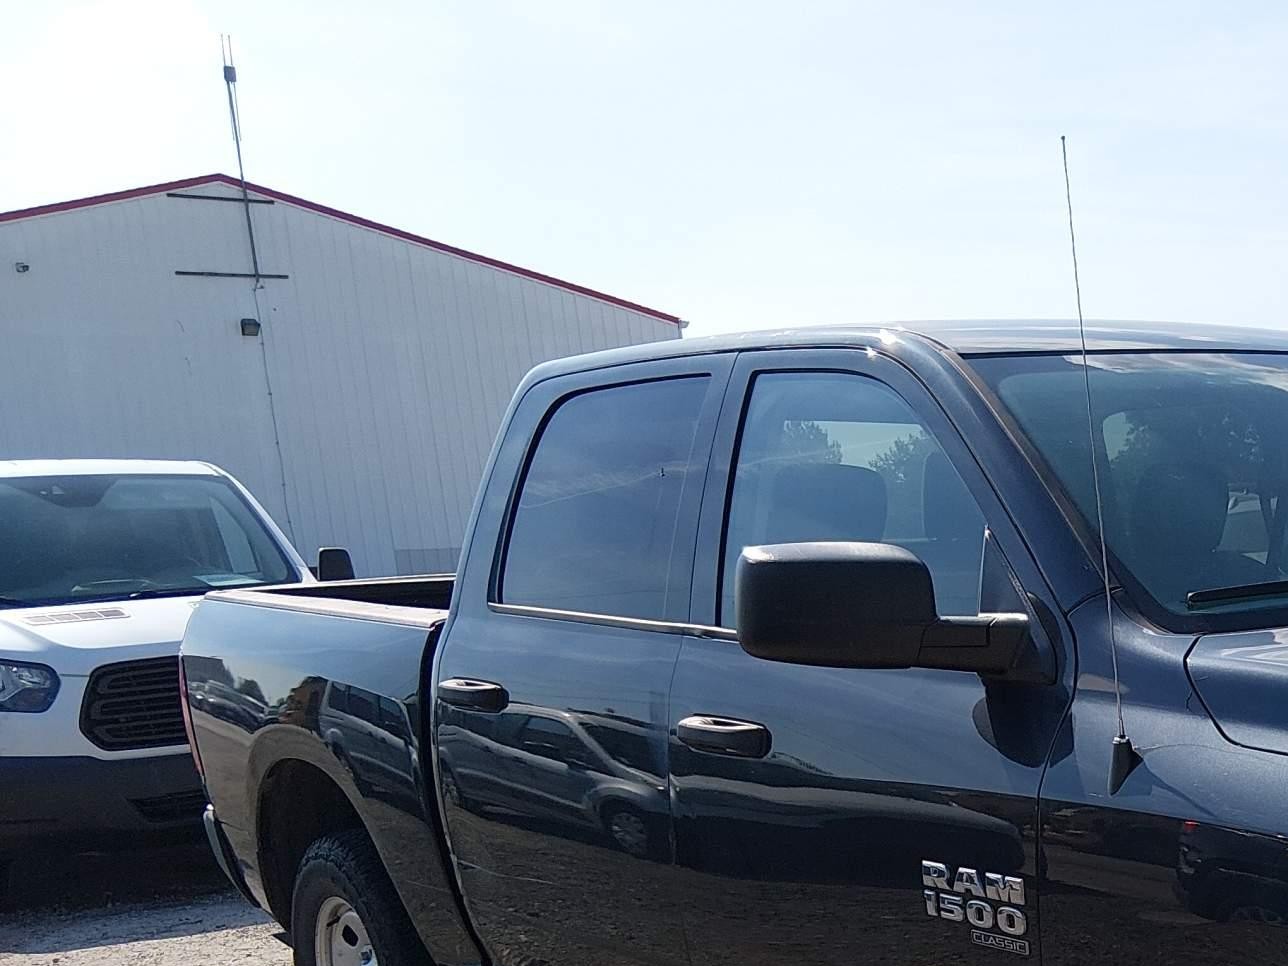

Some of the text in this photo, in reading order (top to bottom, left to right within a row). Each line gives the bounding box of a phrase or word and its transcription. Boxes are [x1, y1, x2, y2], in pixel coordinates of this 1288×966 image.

[921, 859, 1026, 906] RAM
[923, 889, 1027, 936] 1500
[972, 931, 1027, 954] CLASSIC
